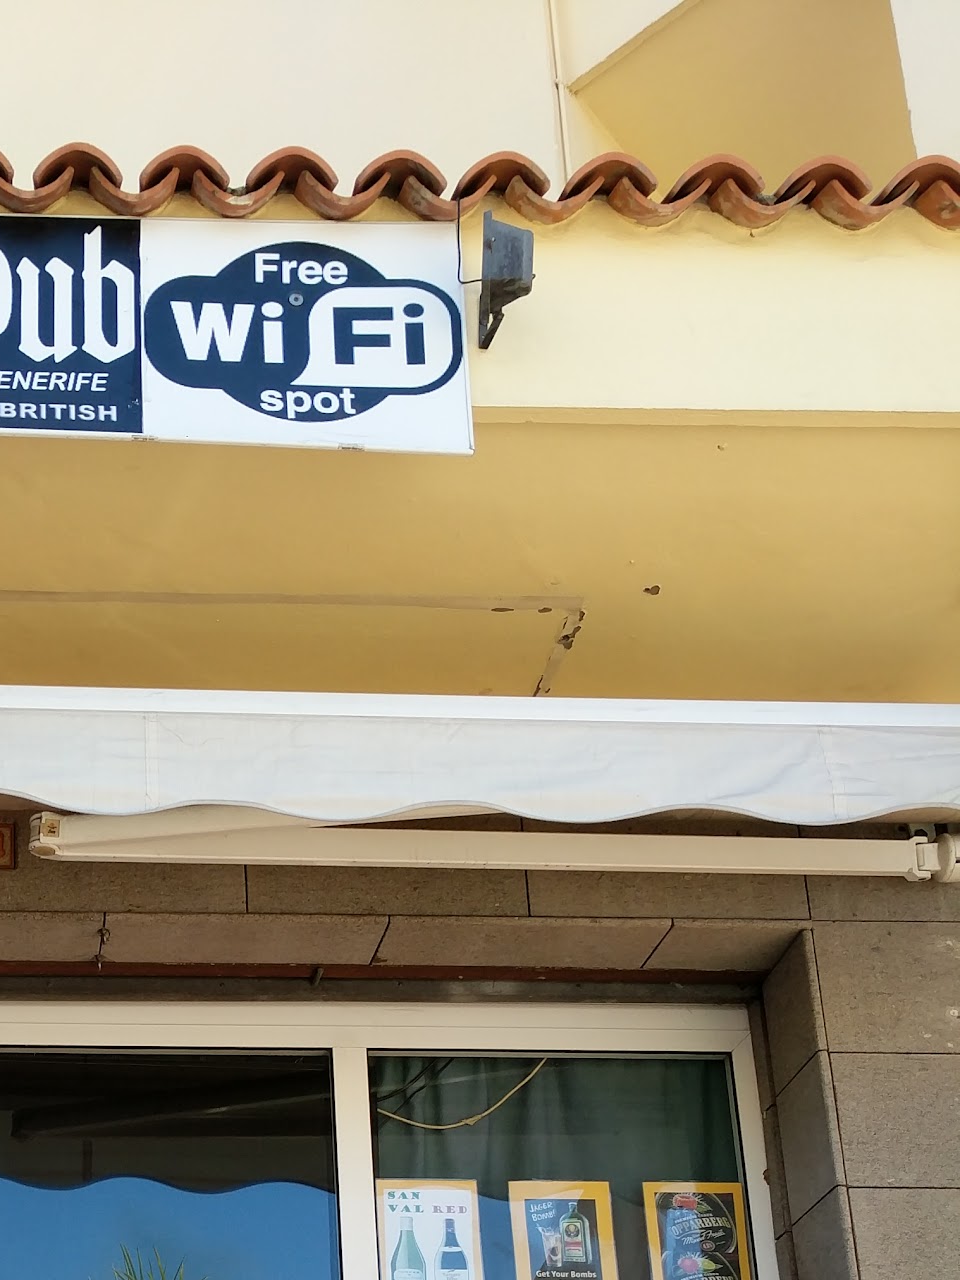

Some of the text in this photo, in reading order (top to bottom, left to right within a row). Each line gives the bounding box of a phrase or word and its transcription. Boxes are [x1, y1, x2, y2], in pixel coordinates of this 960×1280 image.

[254, 252, 349, 285] Free
[259, 387, 357, 419] spot
[387, 1191, 421, 1200] SAN
[387, 1204, 468, 1214] VAL RED
[671, 1216, 731, 1236] OPPARBERG
[536, 1270, 550, 1278] Get
[570, 1270, 597, 1279] Bombs
